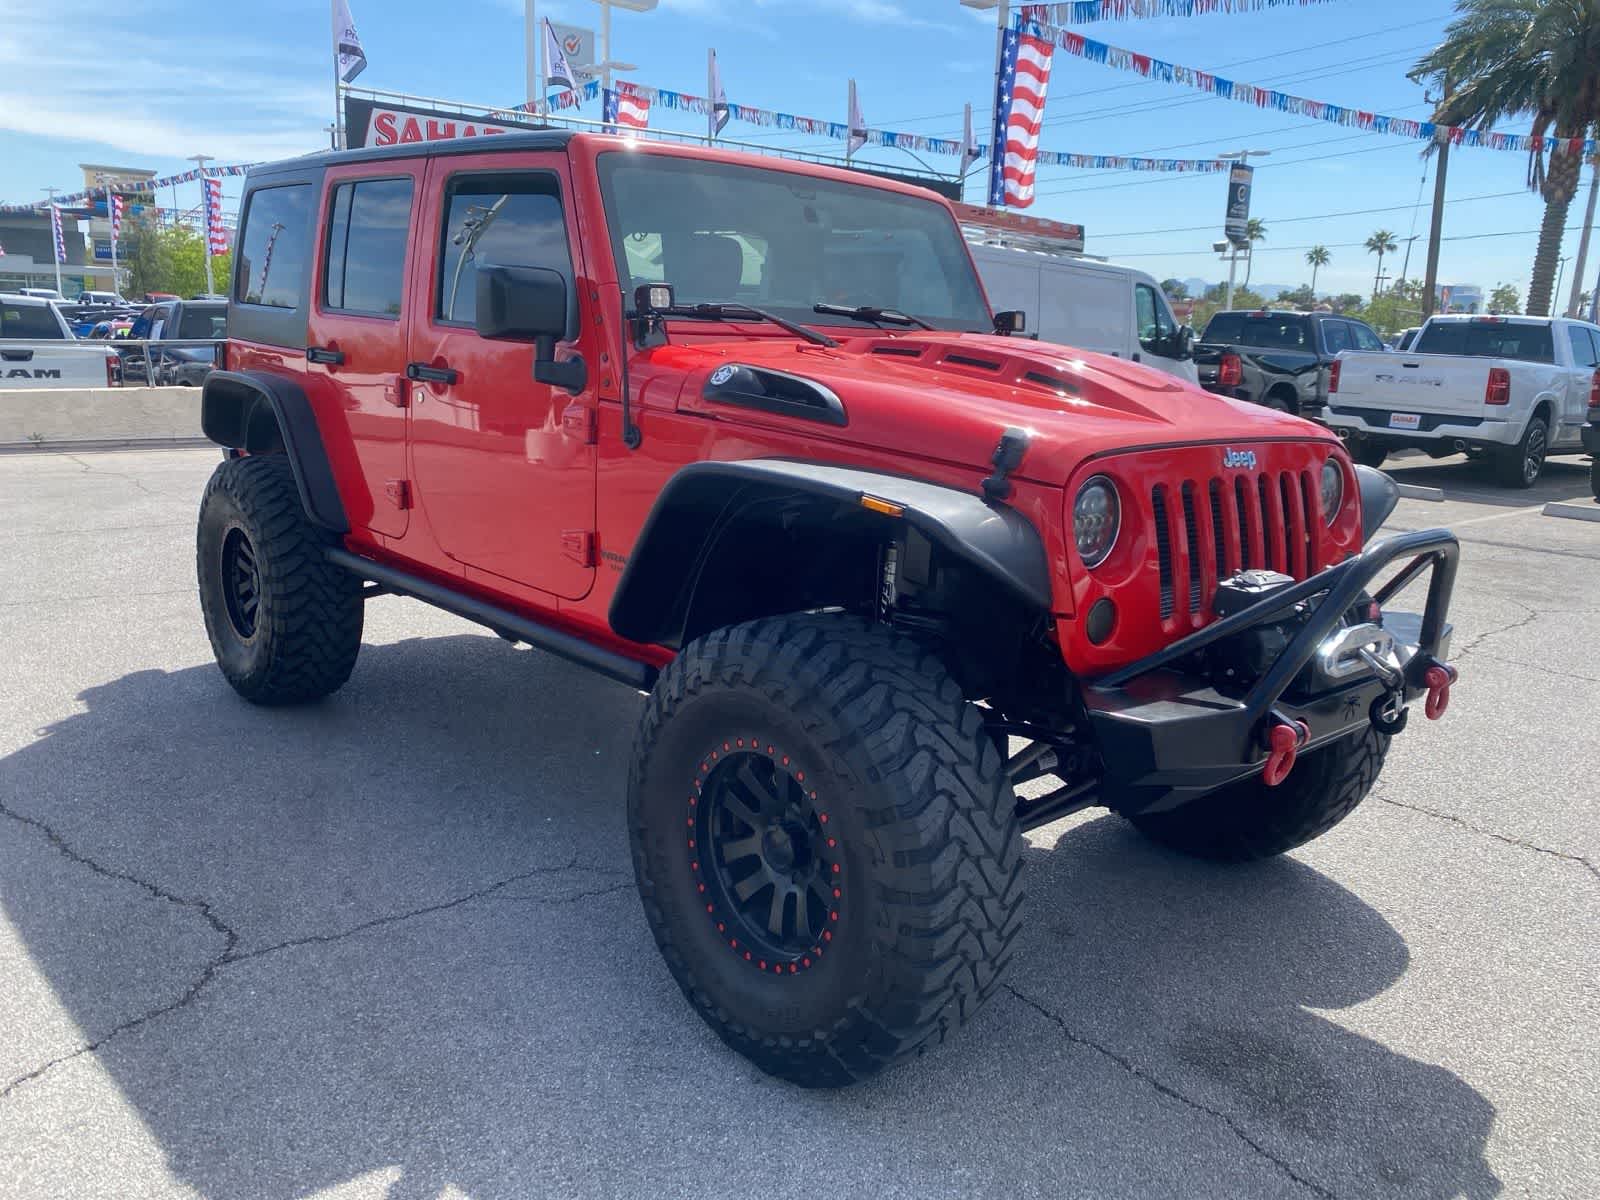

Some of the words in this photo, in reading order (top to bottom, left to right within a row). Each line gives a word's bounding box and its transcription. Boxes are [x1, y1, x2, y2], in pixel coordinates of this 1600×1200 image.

[375, 112, 504, 146] SAH
[0, 369, 61, 378] AM
[1223, 447, 1256, 470] Jeep
